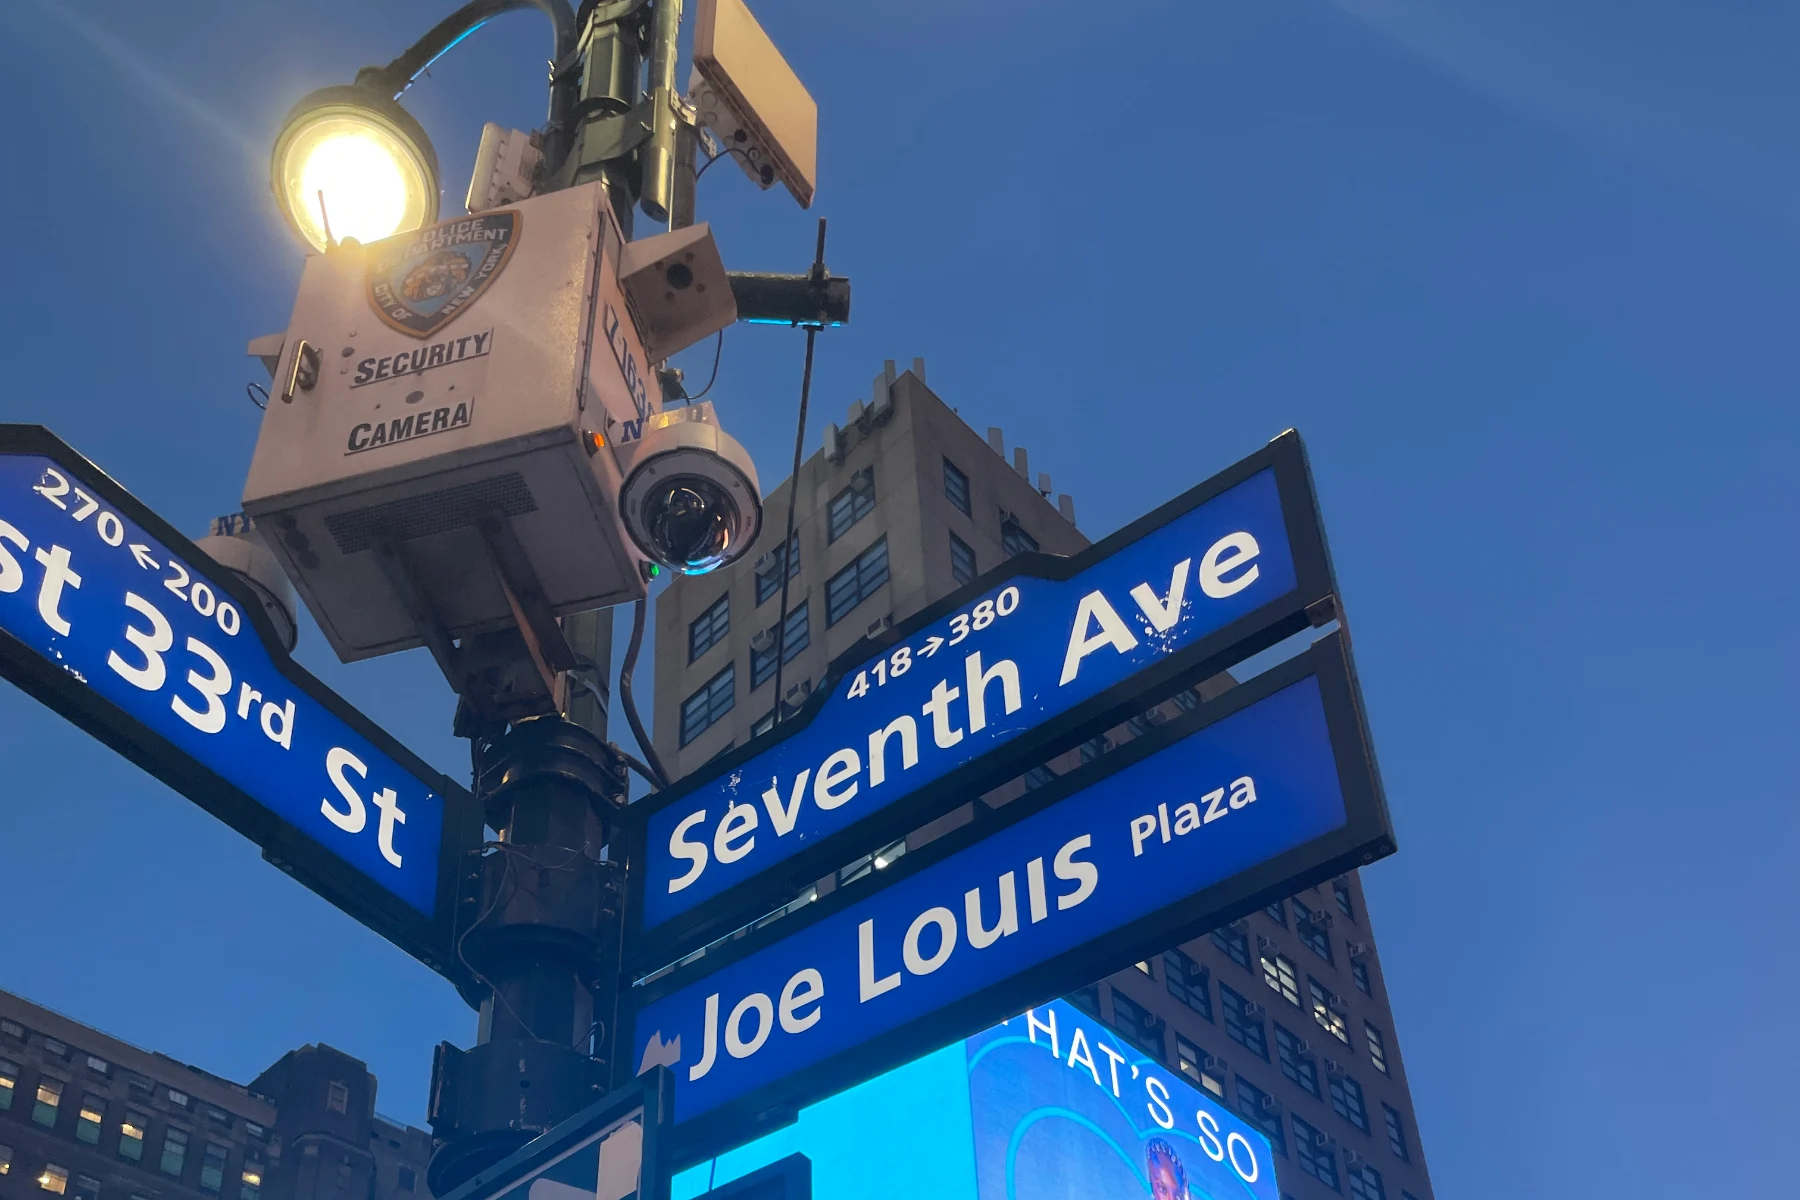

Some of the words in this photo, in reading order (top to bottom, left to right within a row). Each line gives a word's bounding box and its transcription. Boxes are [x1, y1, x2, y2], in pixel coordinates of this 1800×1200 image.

[414, 219, 484, 243] OLICE
[441, 286, 475, 314] NEW
[474, 244, 508, 280] YORK
[348, 402, 468, 451] CAMERA
[354, 332, 489, 384] SECURITY
[34, 468, 124, 547] 270
[163, 561, 241, 637] 200
[667, 650, 1022, 895] Seventh
[1058, 530, 1260, 687] Ave
[847, 646, 912, 700] 418
[947, 586, 1020, 649] 380
[107, 591, 296, 751] 33rd
[321, 747, 406, 868] St
[688, 966, 824, 1082] Joe
[859, 834, 1098, 1004] Louis
[1130, 773, 1258, 859] Plaza
[1002, 1006, 1175, 1130] HAT'S
[1196, 1110, 1258, 1183] SO
